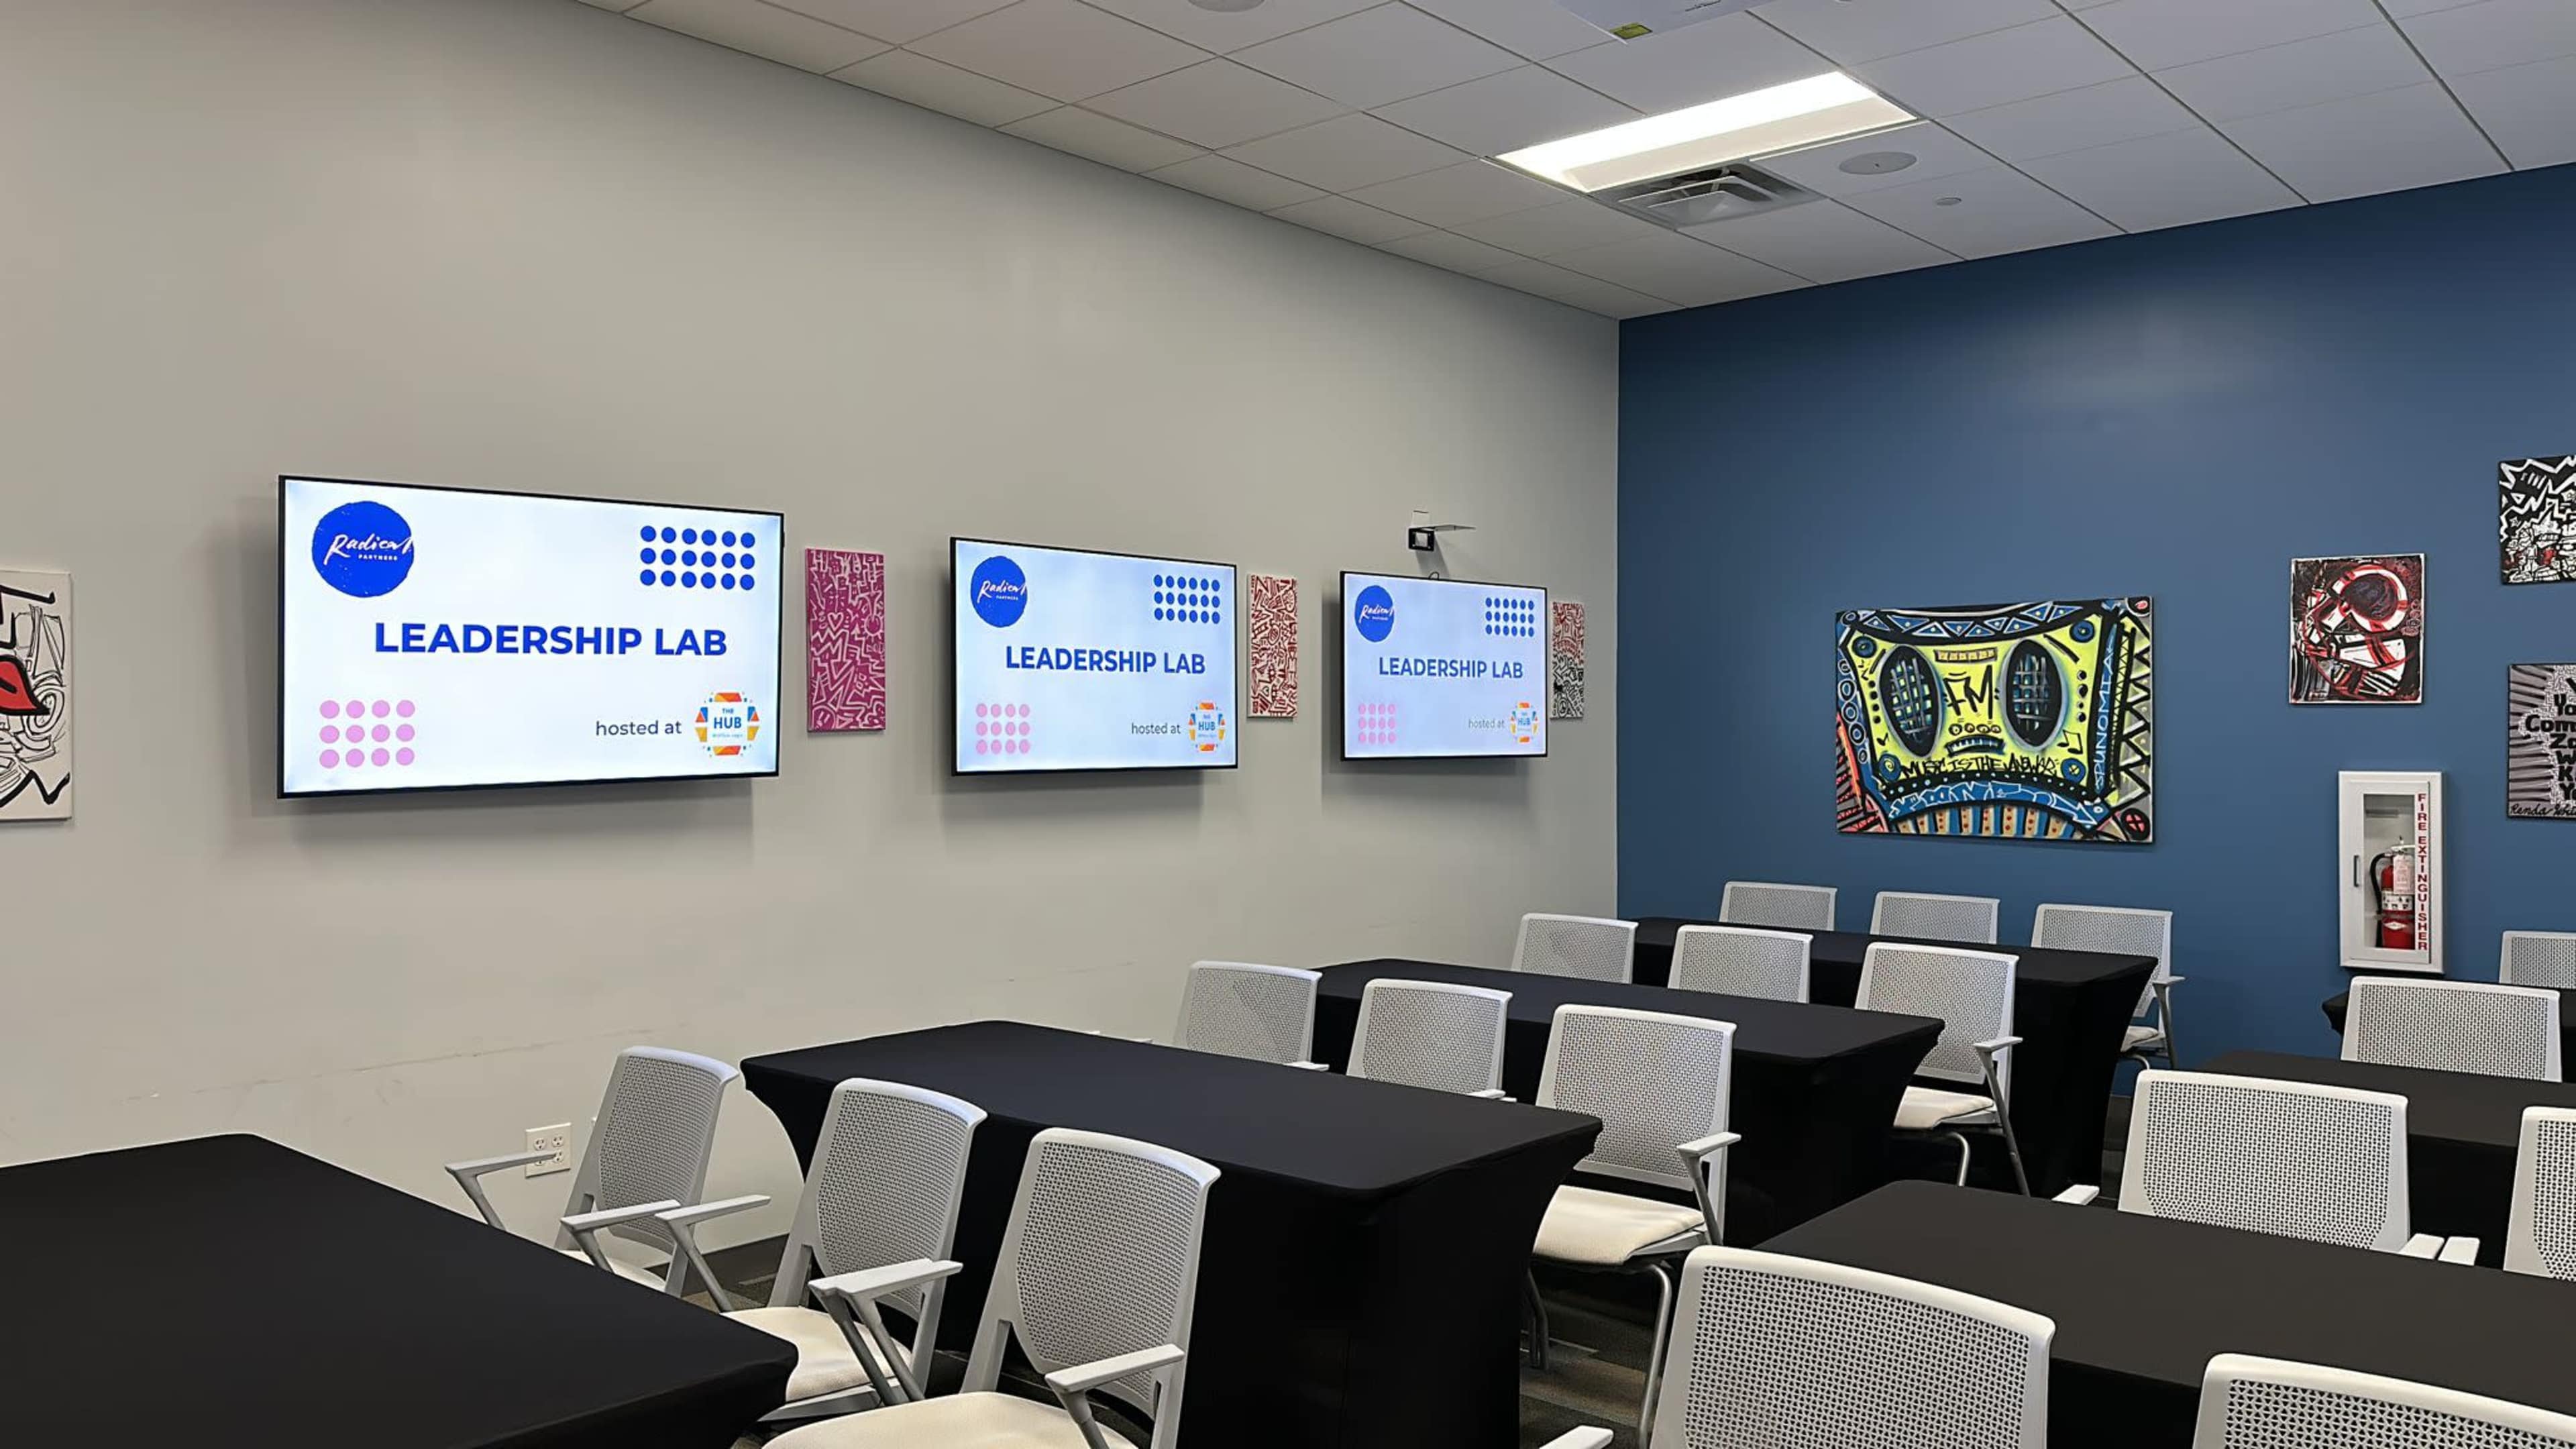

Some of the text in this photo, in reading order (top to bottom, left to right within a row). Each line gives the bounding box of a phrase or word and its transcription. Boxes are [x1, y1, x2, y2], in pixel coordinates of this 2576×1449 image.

[323, 533, 415, 565] Radical
[977, 580, 1028, 603] Radical
[376, 623, 727, 656] LEADERSHIP LAB
[1006, 646, 1205, 674] LEADERSHIP LAB
[1379, 657, 1523, 678] LEADERSHIP LAB
[596, 720, 682, 736] hosted at
[713, 717, 742, 729] HUB
[1131, 722, 1181, 734] hosted at
[1198, 721, 1216, 731] HUB
[1468, 718, 1495, 729] hosted
[2418, 794, 2427, 950] FIRE EXTINGUISHER
